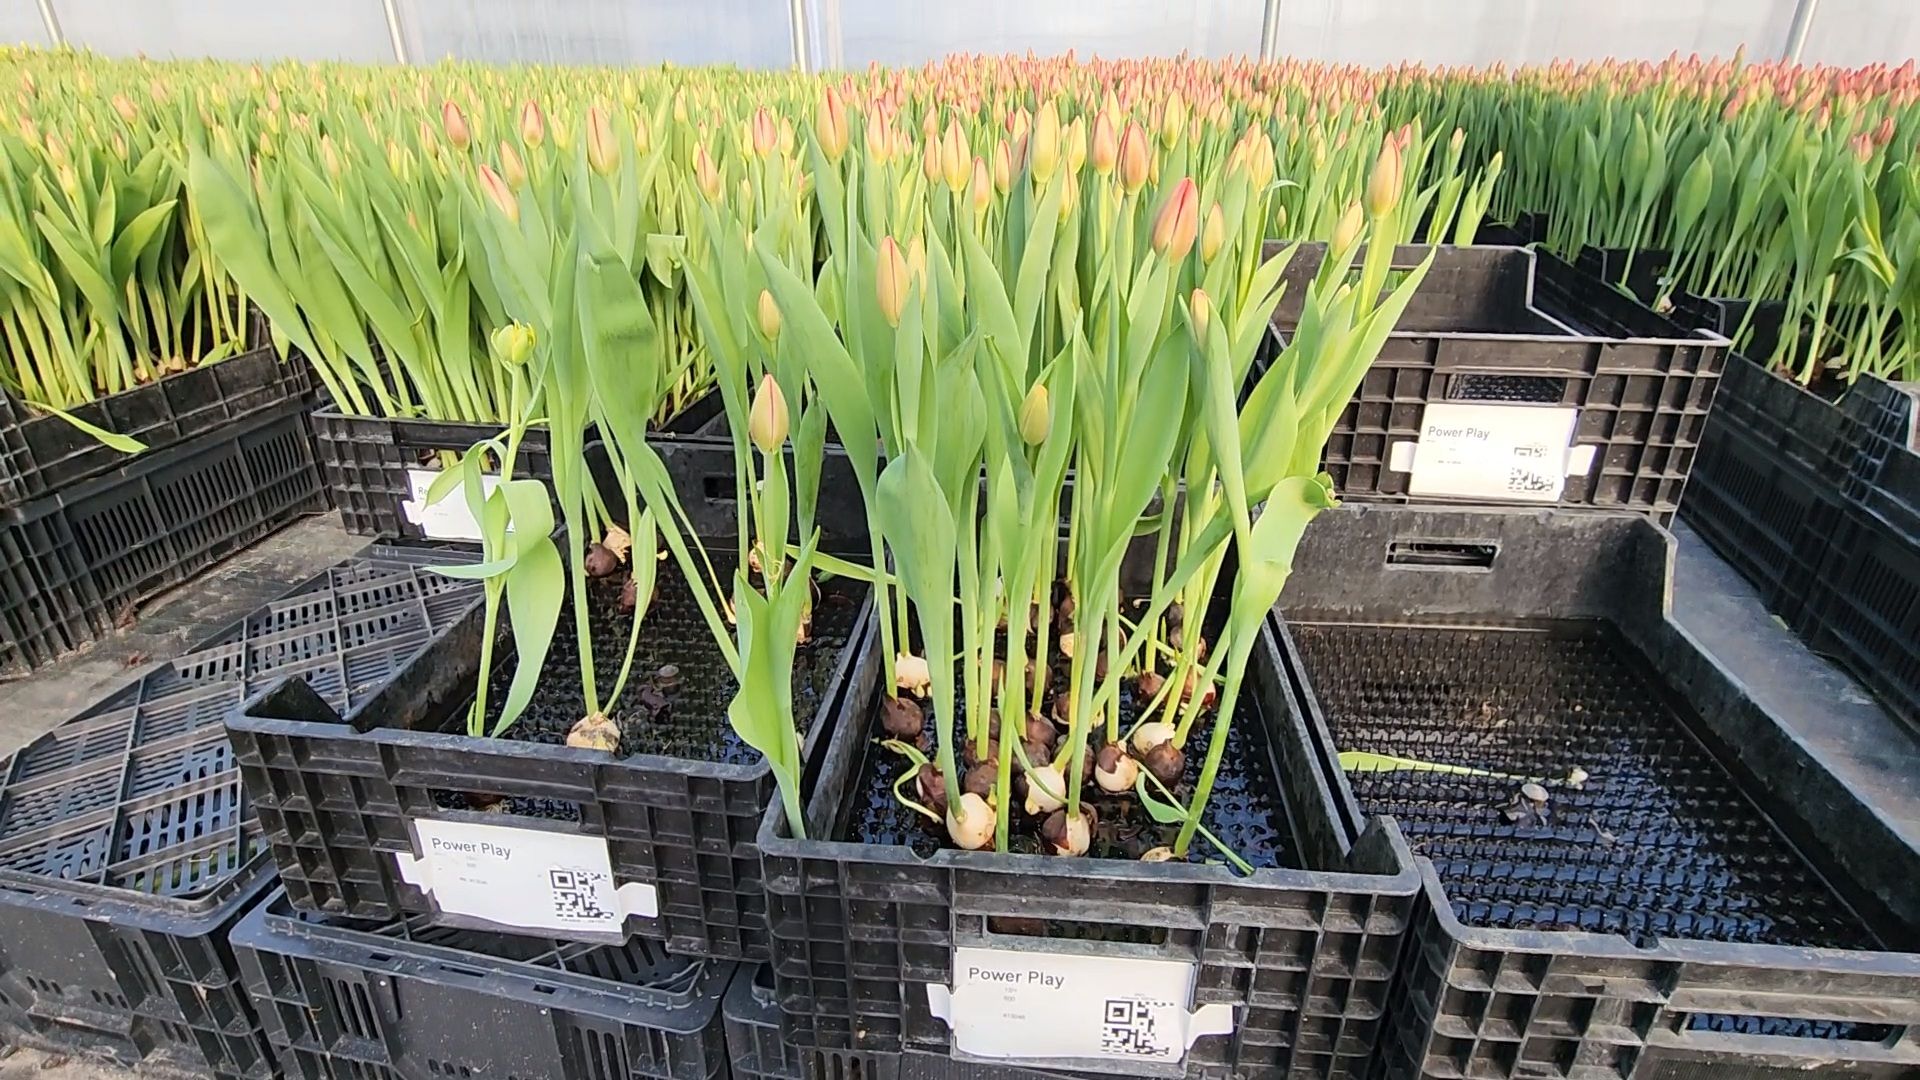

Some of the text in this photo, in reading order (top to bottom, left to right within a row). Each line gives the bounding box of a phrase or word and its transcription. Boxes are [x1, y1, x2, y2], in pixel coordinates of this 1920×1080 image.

[1428, 425, 1490, 441] Power Play
[431, 837, 511, 861] Power Play
[969, 967, 1065, 990] Power Play
